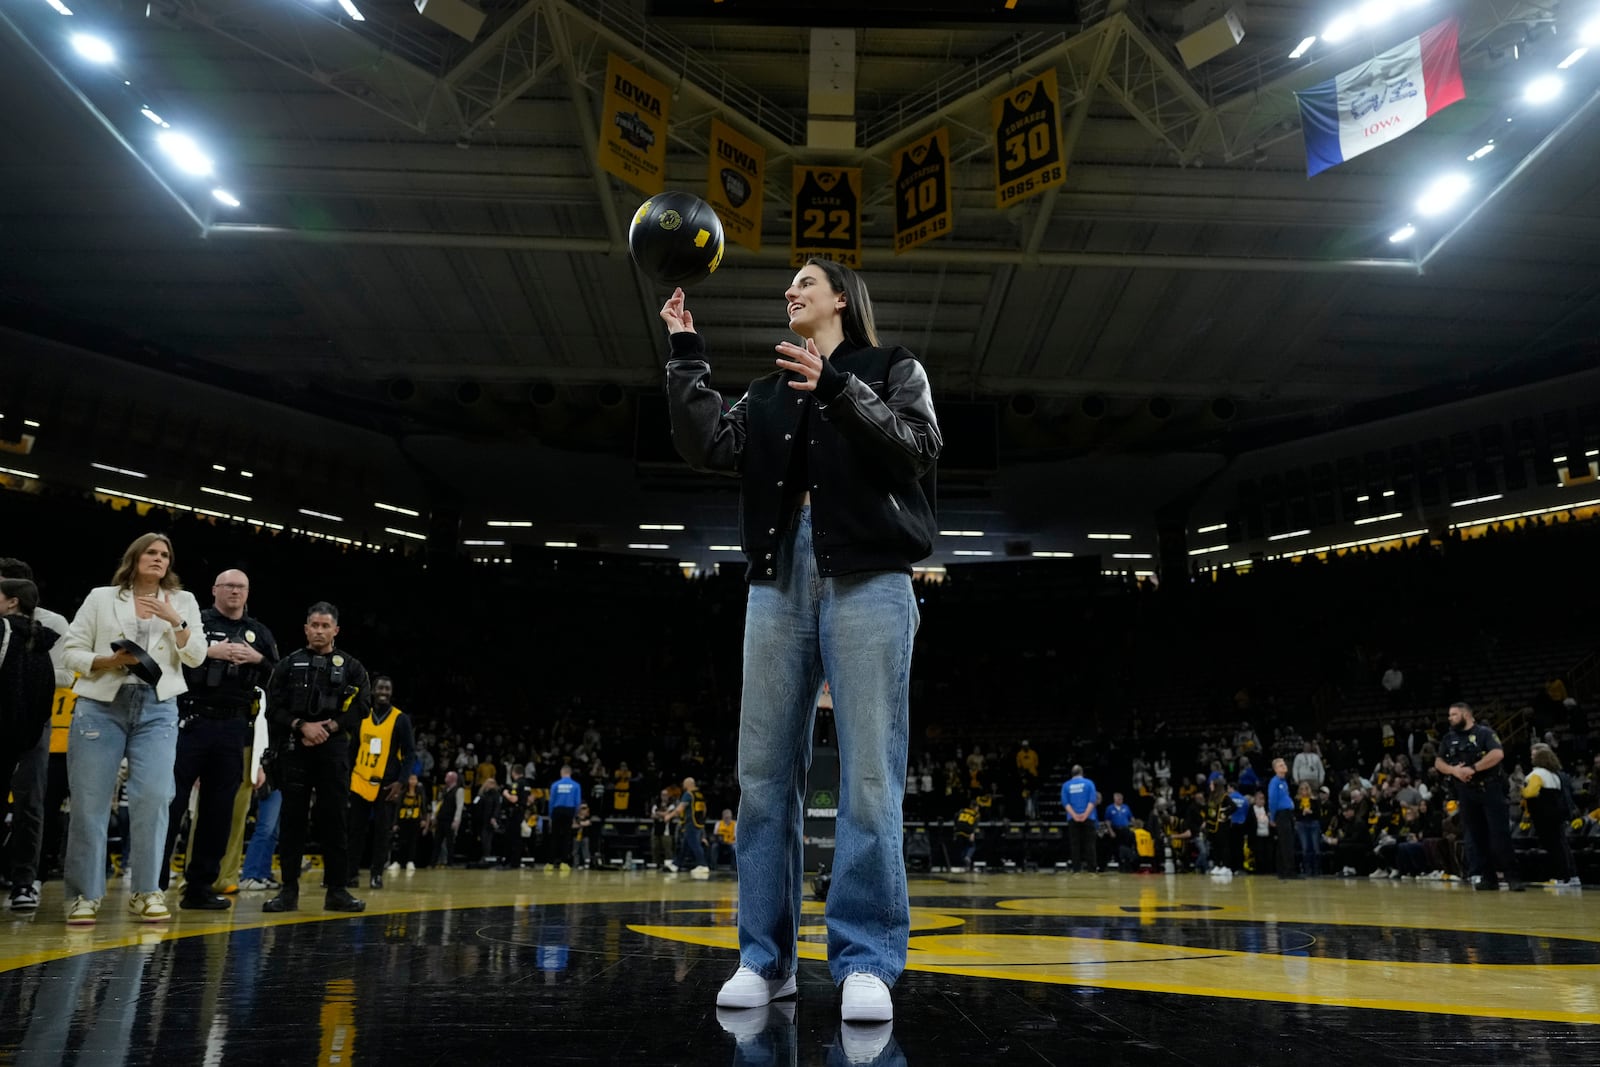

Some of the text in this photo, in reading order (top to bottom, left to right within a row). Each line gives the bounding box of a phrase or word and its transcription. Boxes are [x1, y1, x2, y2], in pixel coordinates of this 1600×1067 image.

[615, 74, 661, 116] IOWA
[1005, 110, 1047, 135] EDWARDS
[1364, 115, 1401, 137] IOWA
[717, 138, 757, 175] IOWA
[1005, 122, 1050, 171] 30
[905, 177, 937, 219] 10
[1001, 167, 1062, 201] 1985-88
[810, 195, 841, 206] CLARK
[803, 209, 850, 240] 22
[898, 218, 946, 249] 2016-19
